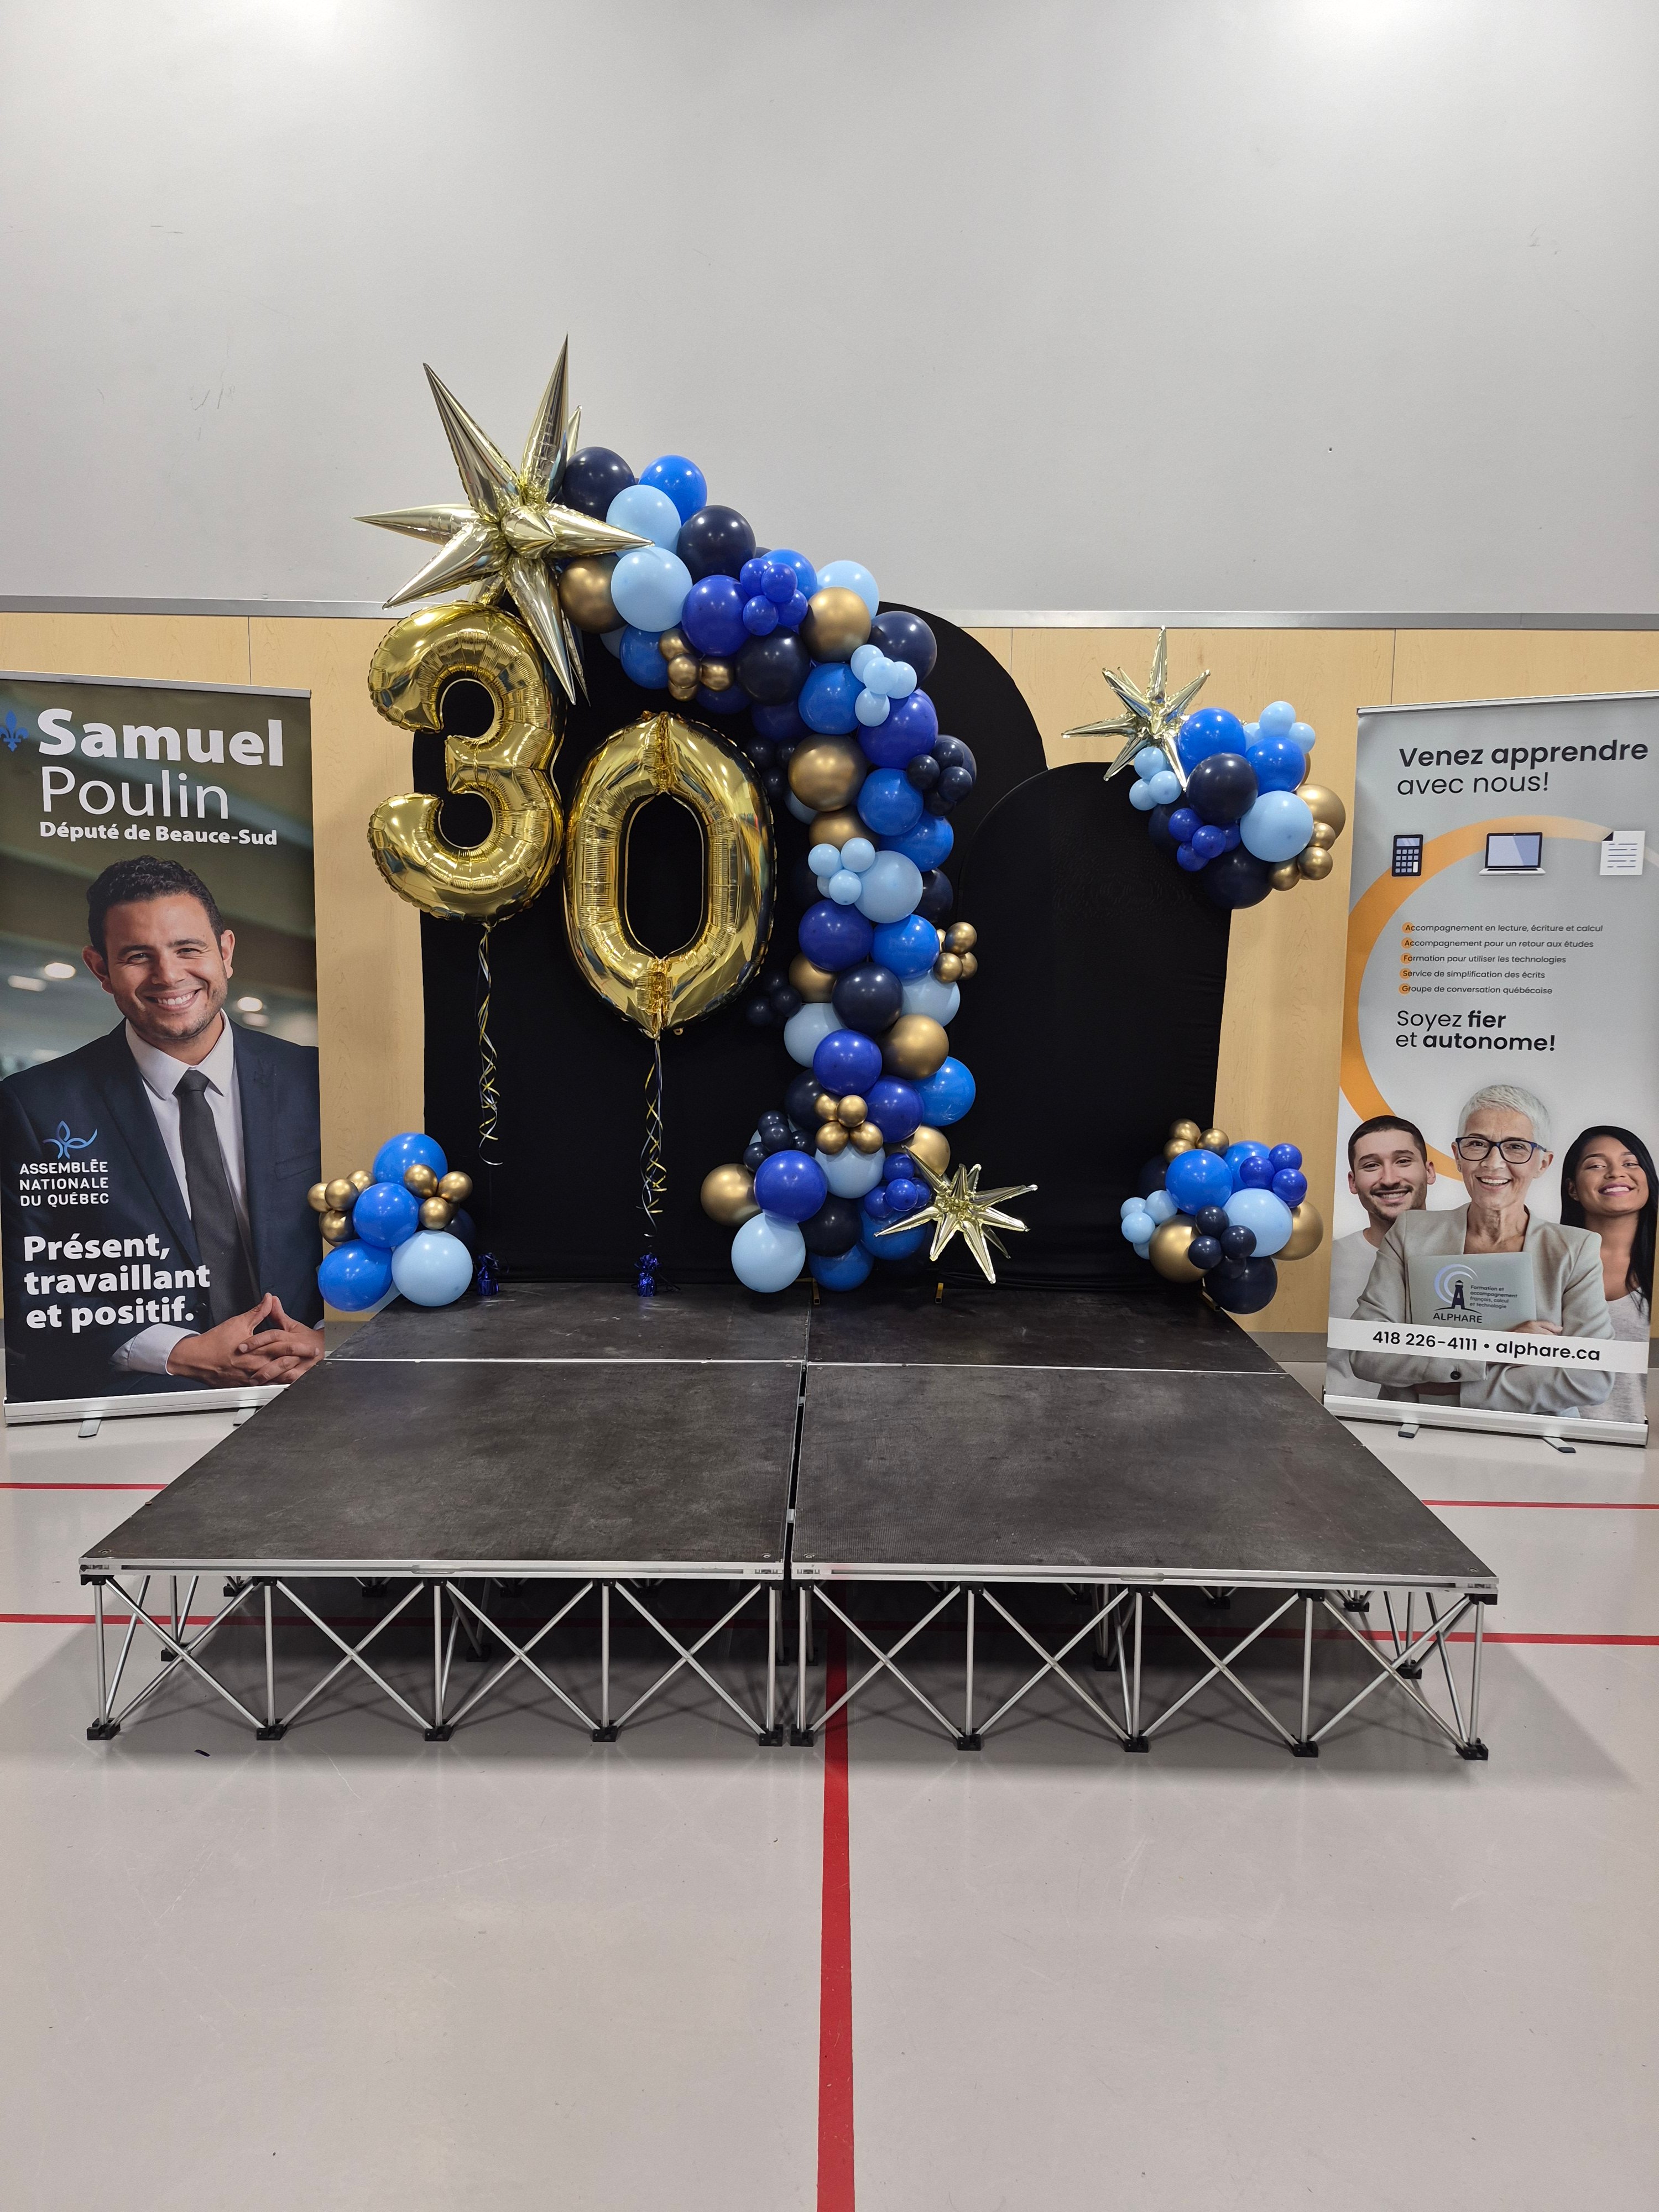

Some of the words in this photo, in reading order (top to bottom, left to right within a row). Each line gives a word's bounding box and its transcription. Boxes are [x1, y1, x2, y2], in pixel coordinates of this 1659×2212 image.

[37, 708, 283, 766] Samuel
[1399, 748, 1483, 768] Venez
[1491, 739, 1648, 770] apprendre
[42, 766, 228, 820] Poulin
[1397, 775, 1464, 795] avec
[1473, 772, 1549, 793] nous!
[40, 821, 119, 842] Député
[124, 825, 150, 841] de
[156, 827, 277, 846] Beauce-Sud
[1405, 925, 1483, 933] Accompagnement
[1404, 940, 1482, 948] Accompagnement
[1511, 956, 1567, 965] technologies
[1446, 971, 1503, 979] simplification
[1401, 985, 1432, 994] Groupe
[1503, 987, 1553, 995] québécoise
[1397, 1010, 1462, 1032] Soyez
[1467, 1010, 1507, 1028] fier
[1395, 1032, 1417, 1048] et
[1422, 1033, 1556, 1052] autonome!
[19, 1159, 108, 1175] ASSEMBLÉE
[19, 1177, 109, 1191] NATIONALE
[20, 1195, 41, 1207] DU
[48, 1192, 109, 1208] QUÉBEC
[24, 1233, 170, 1261] Présent,
[24, 1264, 210, 1295] travaillant
[26, 1305, 62, 1328] et
[71, 1296, 194, 1333] positif.
[1433, 1312, 1483, 1323] ALPHARE
[1373, 1331, 1400, 1345] 418
[1405, 1333, 1478, 1351] 226-4111
[1496, 1340, 1600, 1360] alphare.ca
